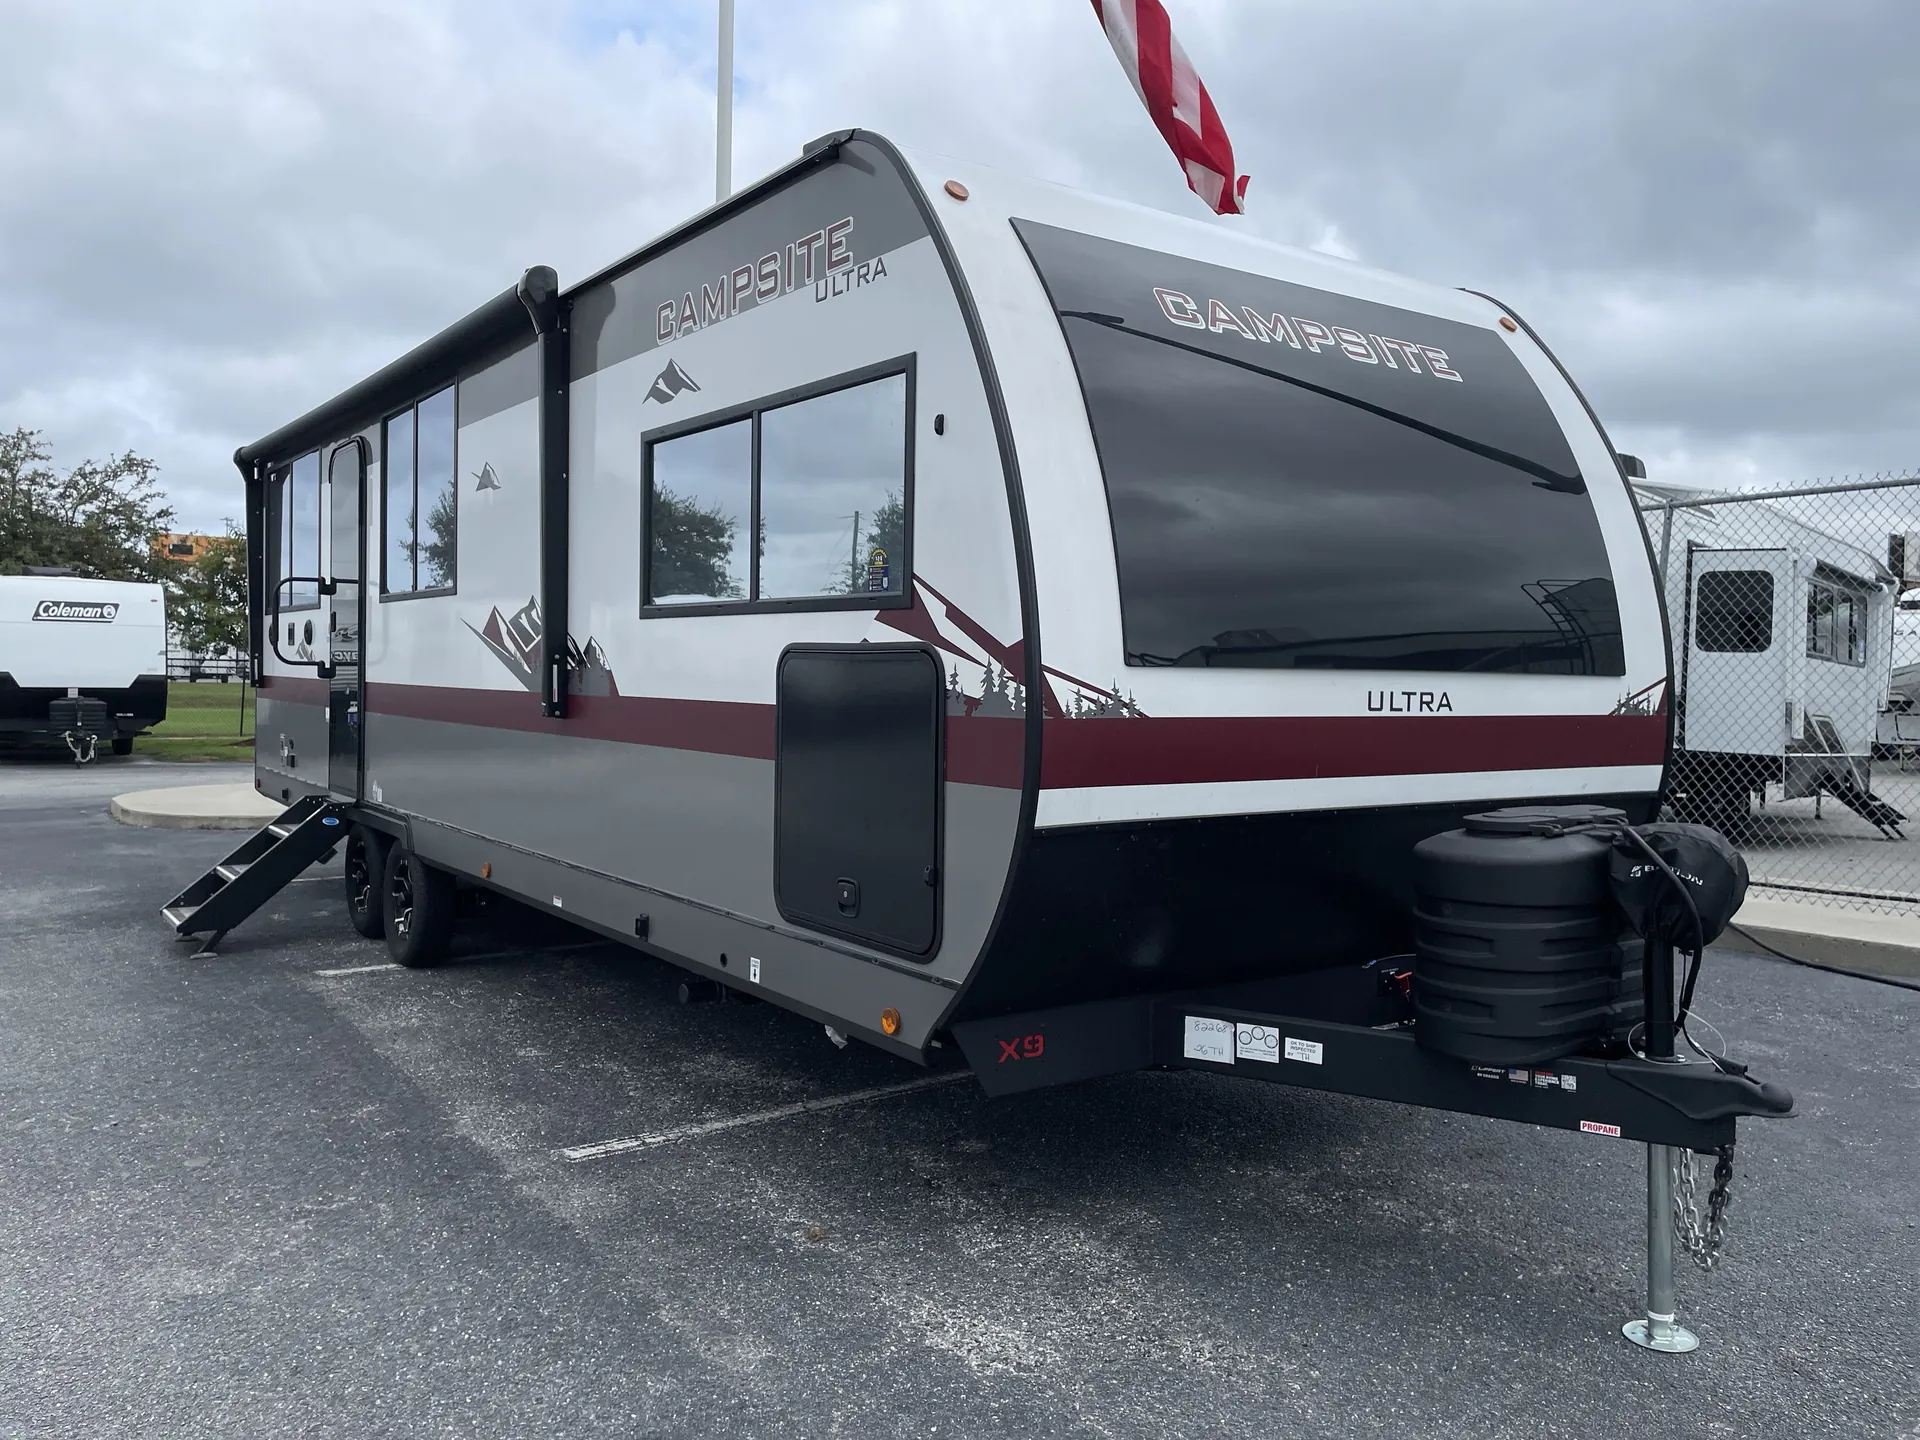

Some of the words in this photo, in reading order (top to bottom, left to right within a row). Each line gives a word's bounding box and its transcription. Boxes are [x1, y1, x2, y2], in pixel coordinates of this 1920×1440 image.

[656, 216, 854, 346] CAMPSITE
[815, 256, 888, 303] ULTRA
[1153, 287, 1463, 382] CAMPSITE
[38, 601, 102, 618] Coleman
[1367, 690, 1453, 712] ULTRA
[998, 1033, 1044, 1064] X9
[1290, 1045, 1316, 1054] INSPECTED
[1581, 1122, 1619, 1136] PROPANE
